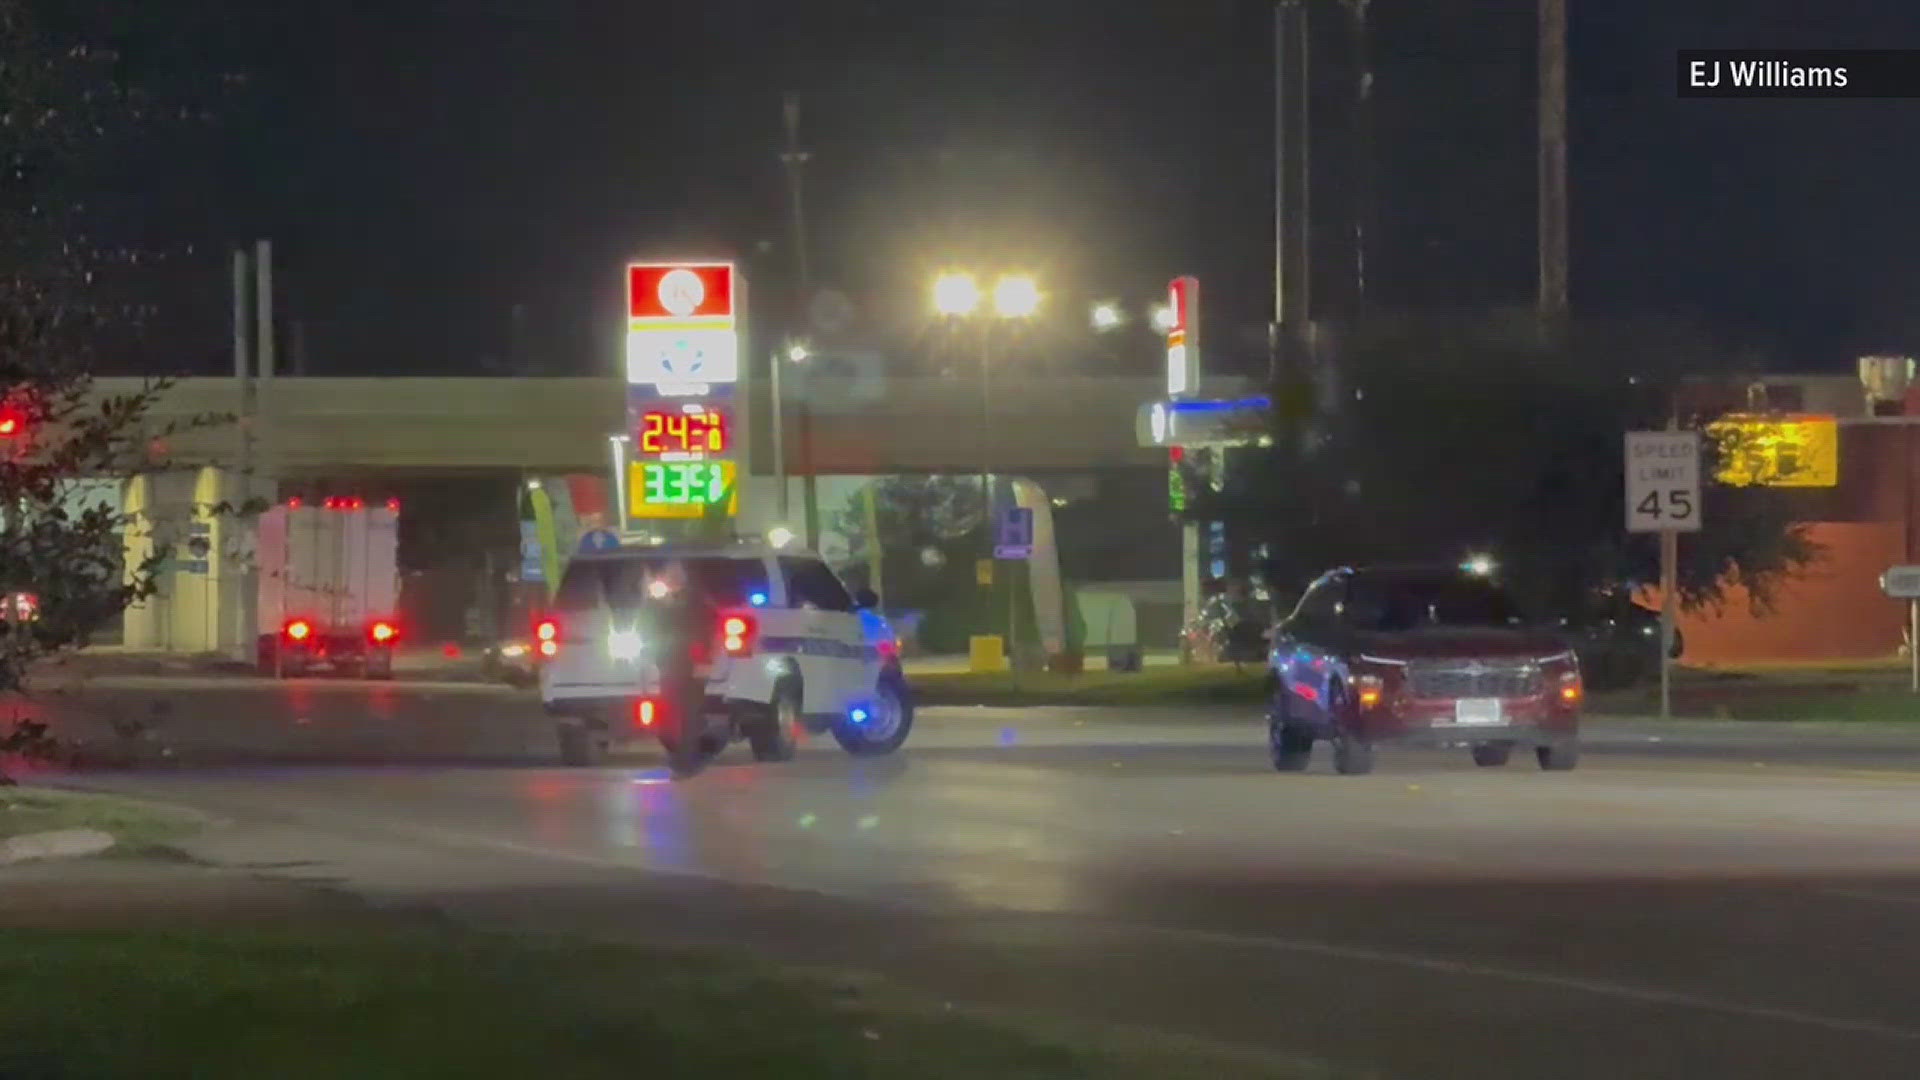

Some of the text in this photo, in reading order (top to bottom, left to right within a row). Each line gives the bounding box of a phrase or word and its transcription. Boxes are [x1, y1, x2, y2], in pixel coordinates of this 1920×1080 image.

[1634, 442, 1693, 458] SPEED
[1640, 466, 1685, 481] LIMIT
[1636, 490, 1692, 520] 45
